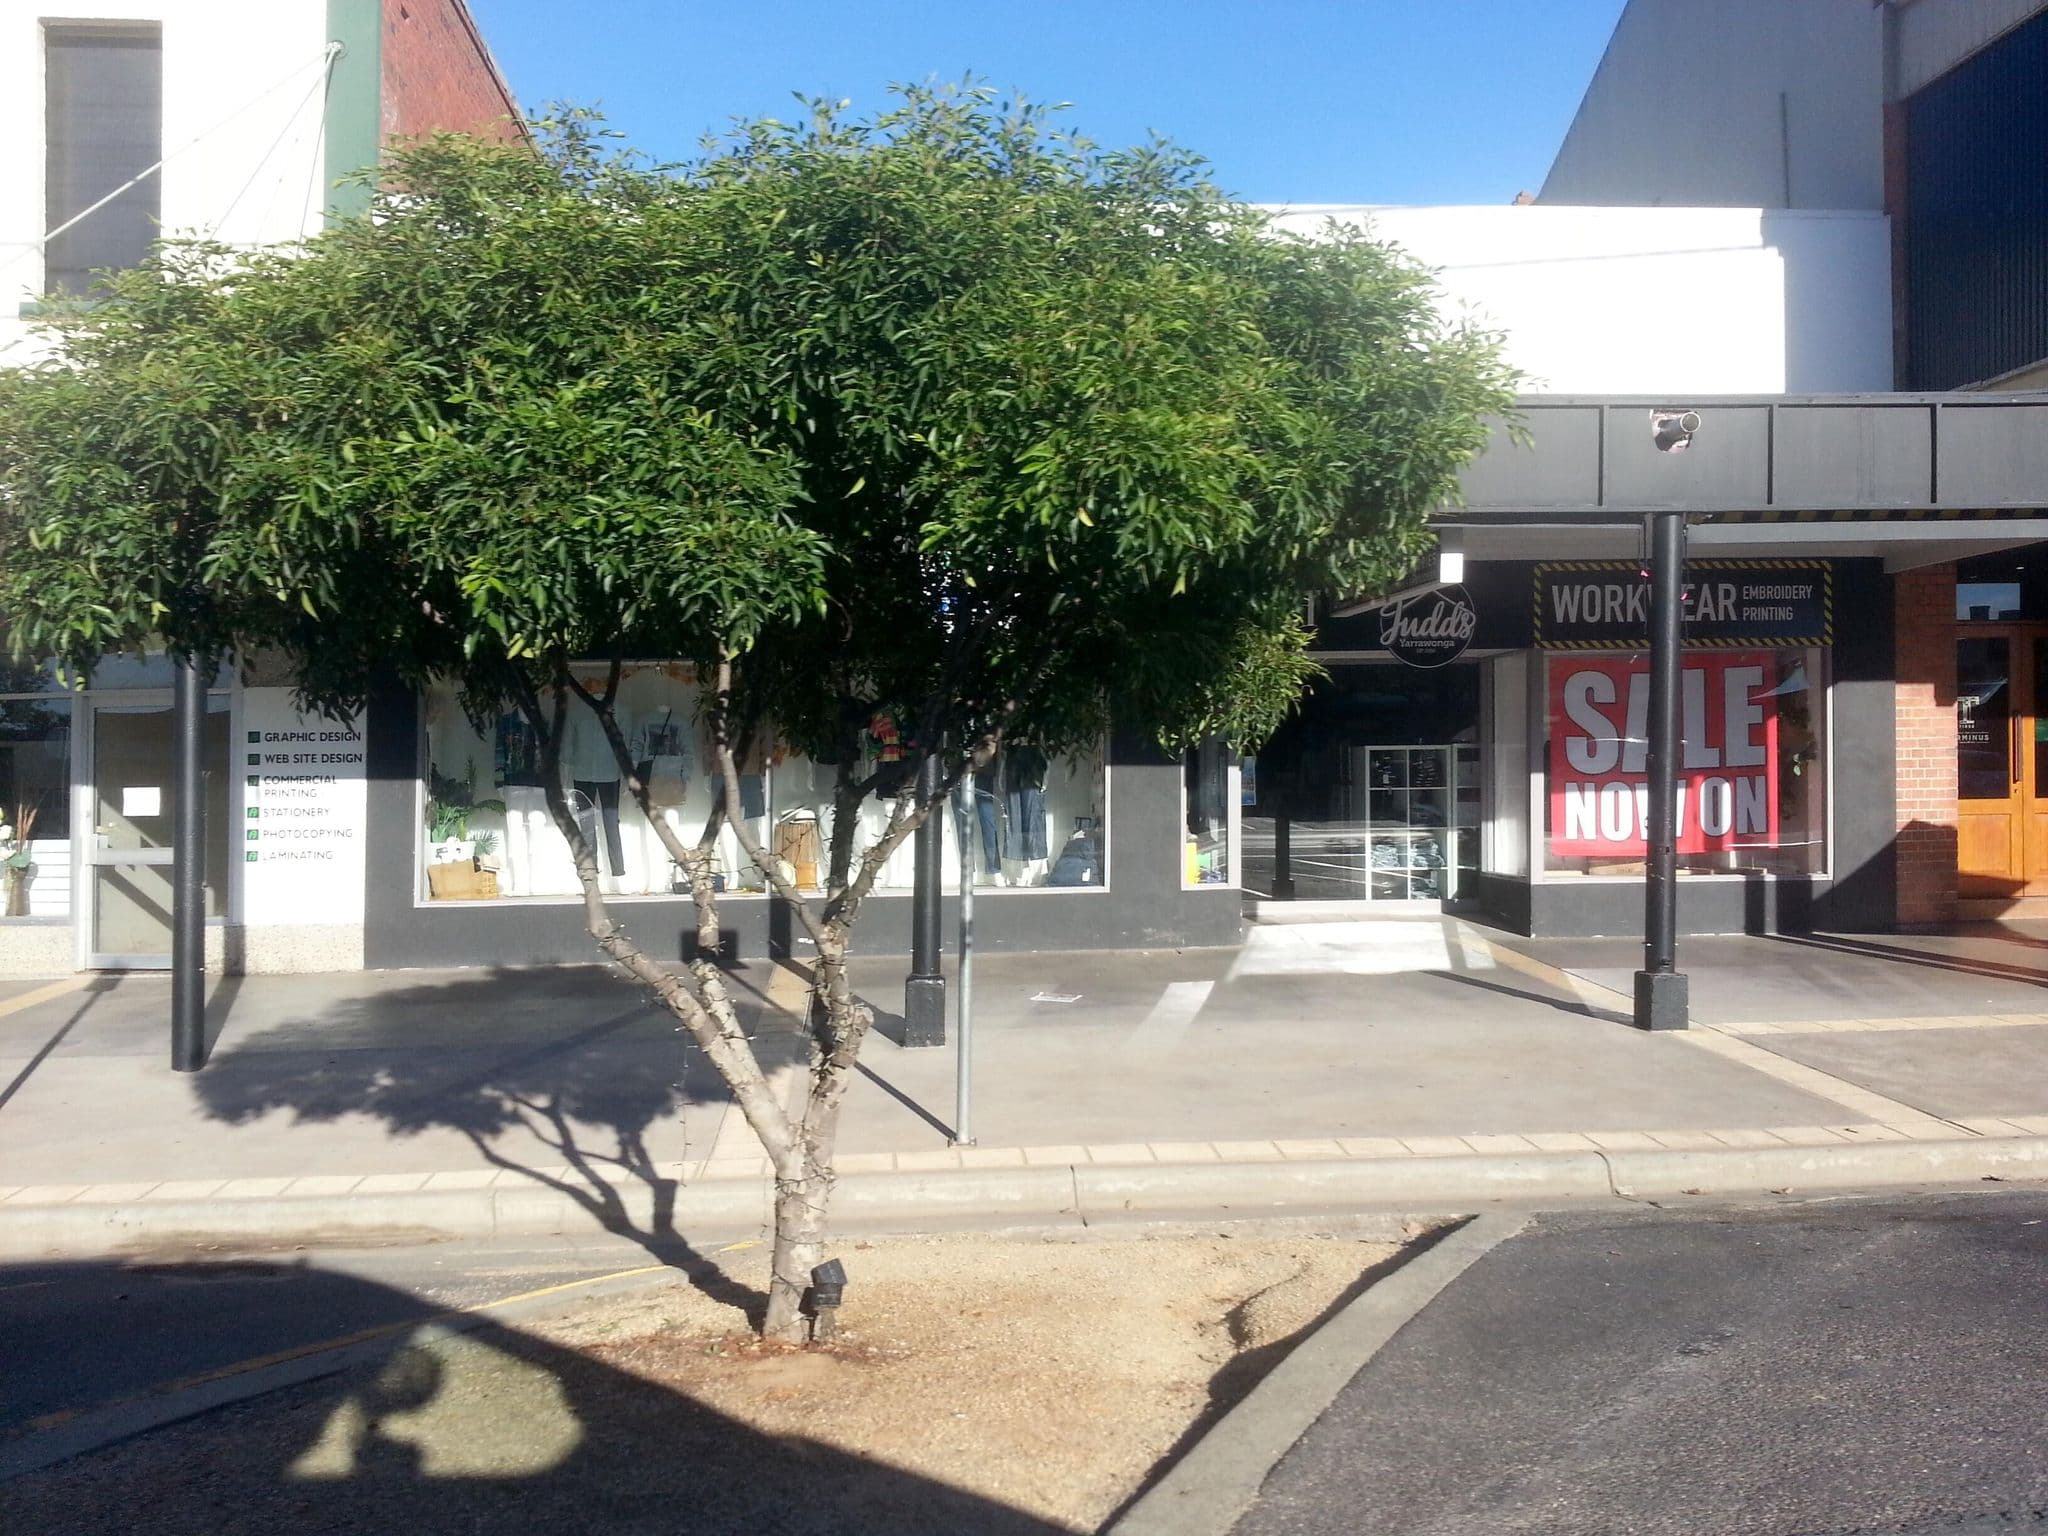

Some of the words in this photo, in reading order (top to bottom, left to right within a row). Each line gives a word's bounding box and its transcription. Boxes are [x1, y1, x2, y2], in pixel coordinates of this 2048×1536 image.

[1742, 584, 1814, 600] EMBROIDERY
[1552, 583, 1738, 623] WORKEAR
[1742, 606, 1794, 622] PRINTING
[1399, 638, 1456, 649] Yarrawonga
[264, 732, 316, 743] GRAPHIC
[319, 731, 361, 742] DESIGN
[264, 754, 290, 764] WEB
[293, 753, 318, 764] SITE
[321, 753, 363, 763] DESIGN
[263, 775, 338, 785] COMMERCIAL
[264, 788, 318, 798] PRINTING
[1699, 775, 1767, 837] ON
[263, 807, 330, 817] STATIONERY
[263, 829, 353, 839] PHOTOCOPYING
[263, 850, 334, 861] LAMINATING
